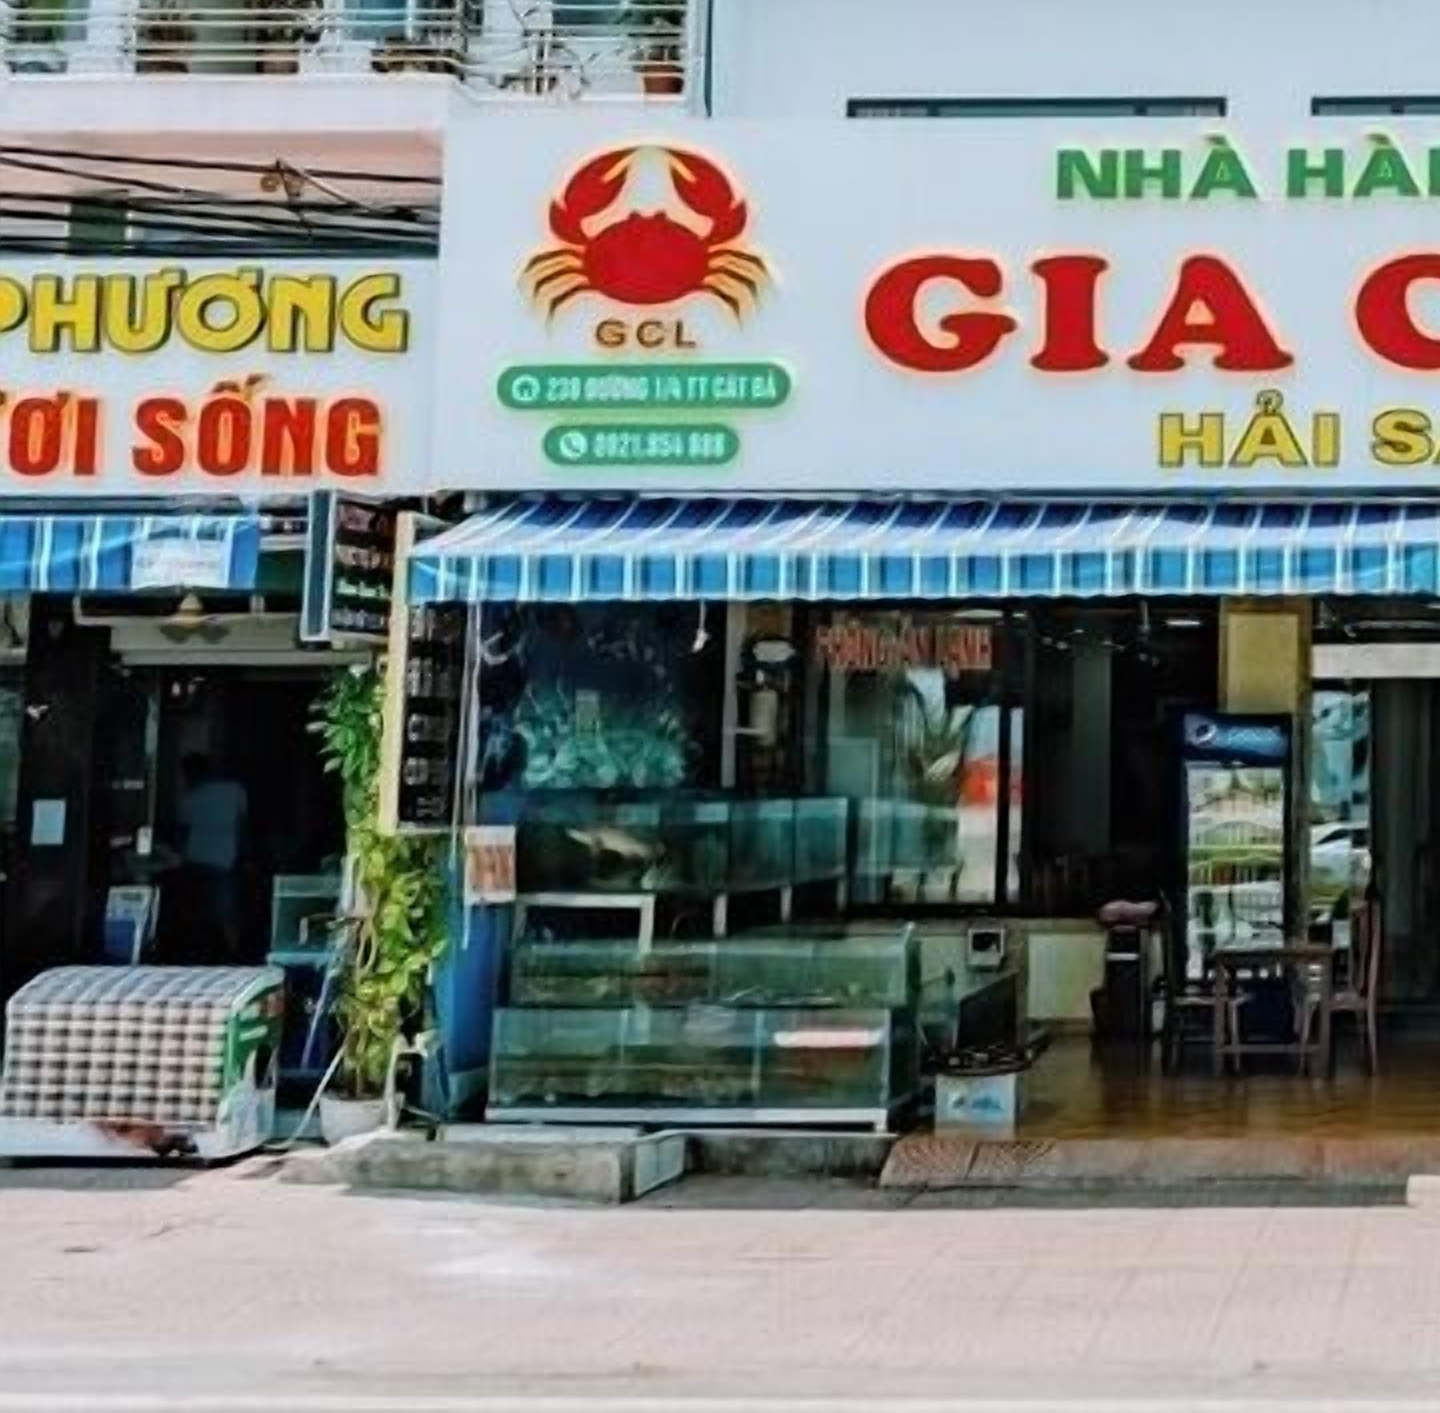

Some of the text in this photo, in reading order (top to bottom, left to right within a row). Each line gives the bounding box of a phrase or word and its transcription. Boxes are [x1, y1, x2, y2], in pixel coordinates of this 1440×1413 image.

[1056, 135, 1258, 200] NHÀ
[596, 320, 697, 348] GCL
[864, 254, 1295, 373] GIA
[132, 372, 381, 477] SỐNG
[1158, 389, 1342, 468] HẢI
